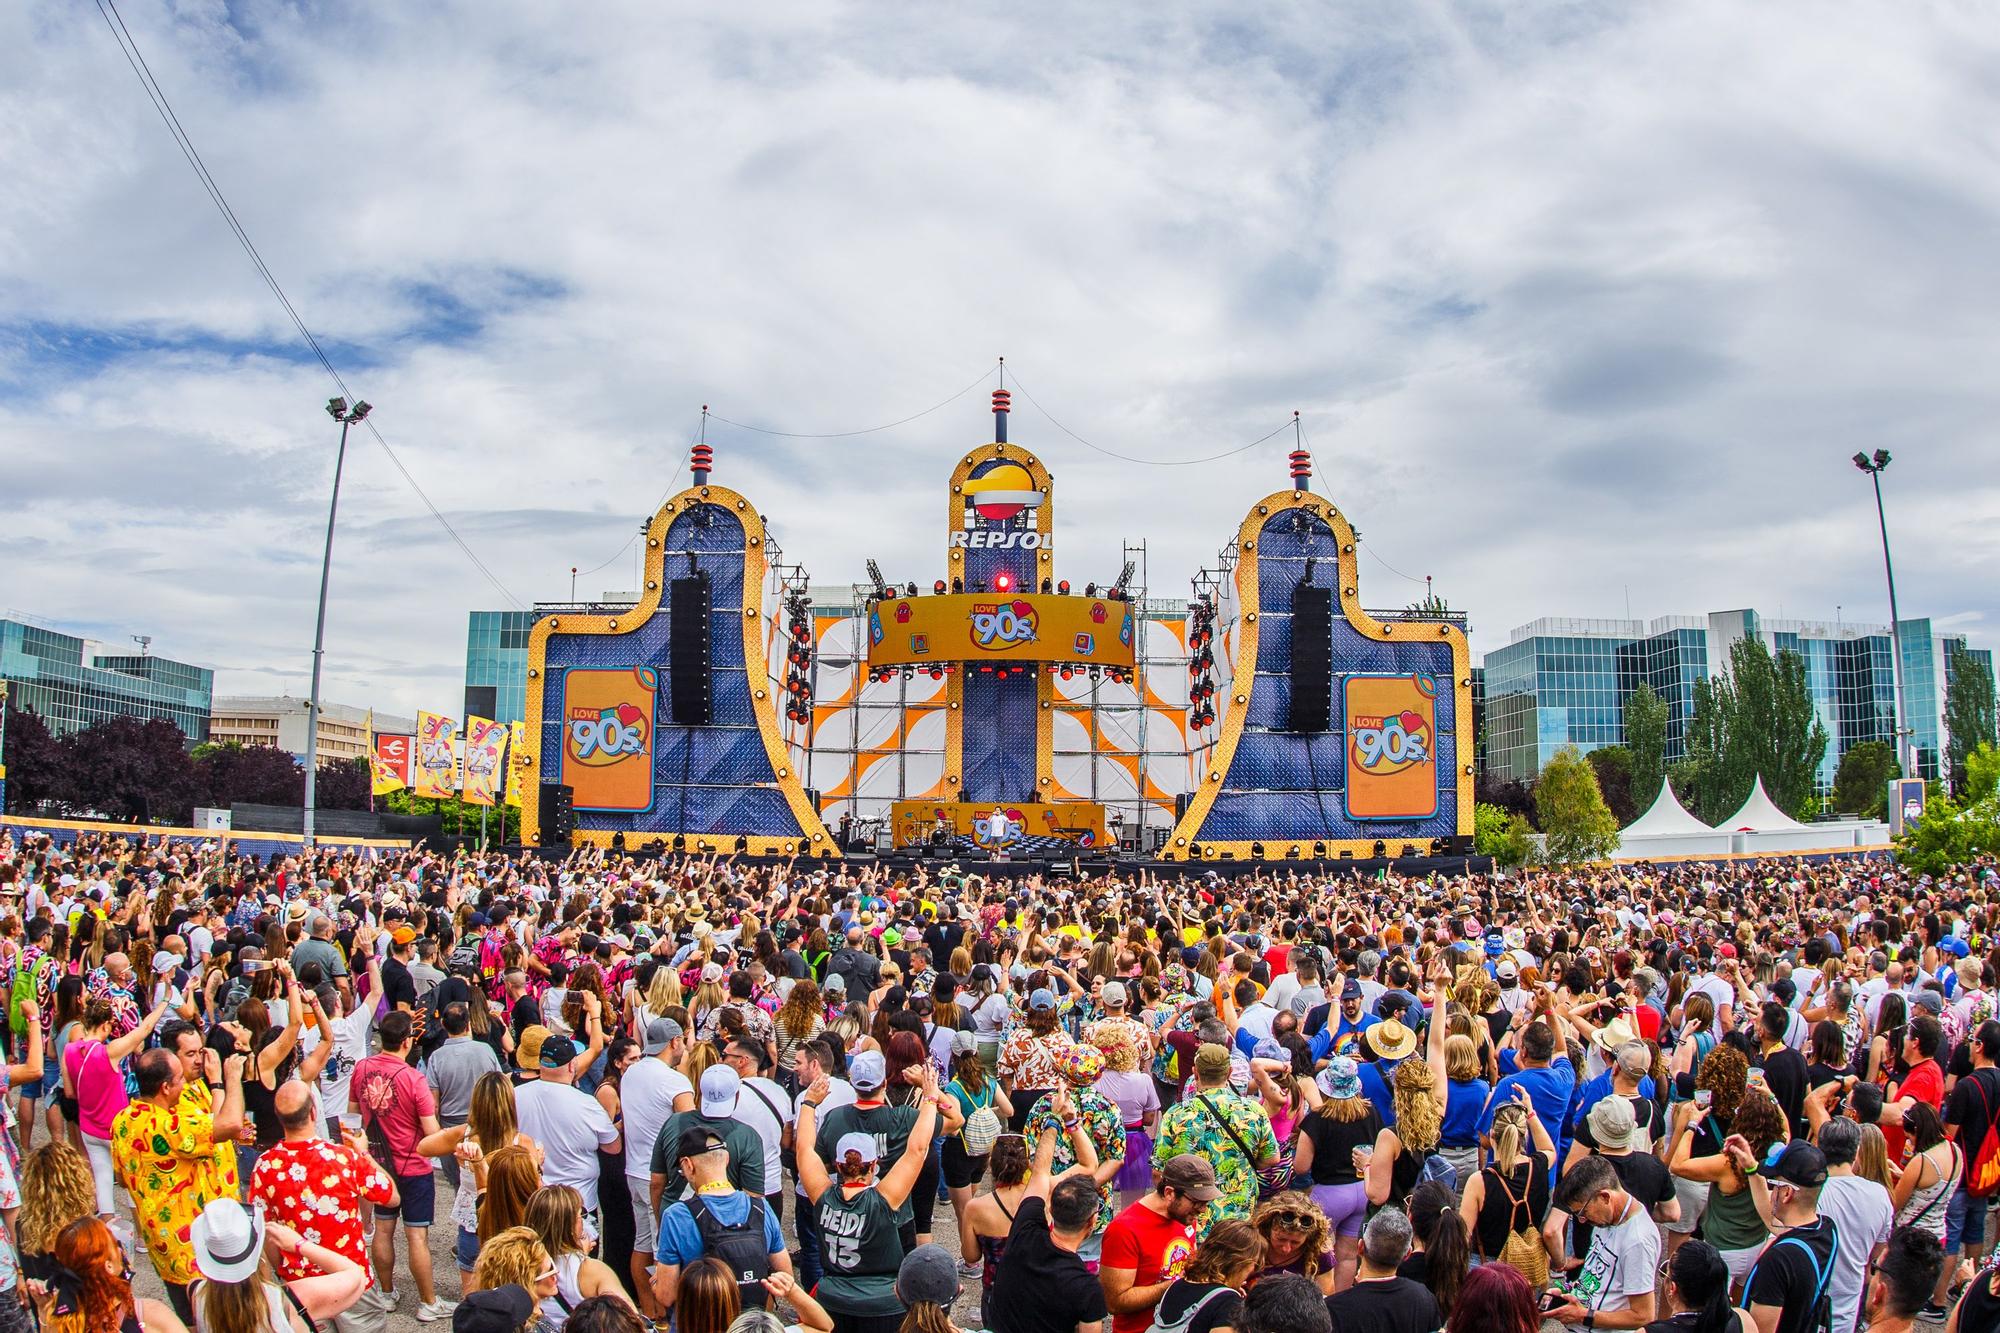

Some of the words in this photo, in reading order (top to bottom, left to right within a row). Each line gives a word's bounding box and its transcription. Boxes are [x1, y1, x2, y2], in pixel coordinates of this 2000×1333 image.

[949, 531, 1053, 550] REPSOL
[975, 605, 997, 613] LOVE
[974, 611, 1032, 644] 90s
[574, 709, 600, 719] LOVE
[1356, 717, 1382, 728] LOVE
[572, 716, 641, 758] 90s
[1356, 725, 1426, 767] 90s
[819, 1203, 867, 1238] HEIDI
